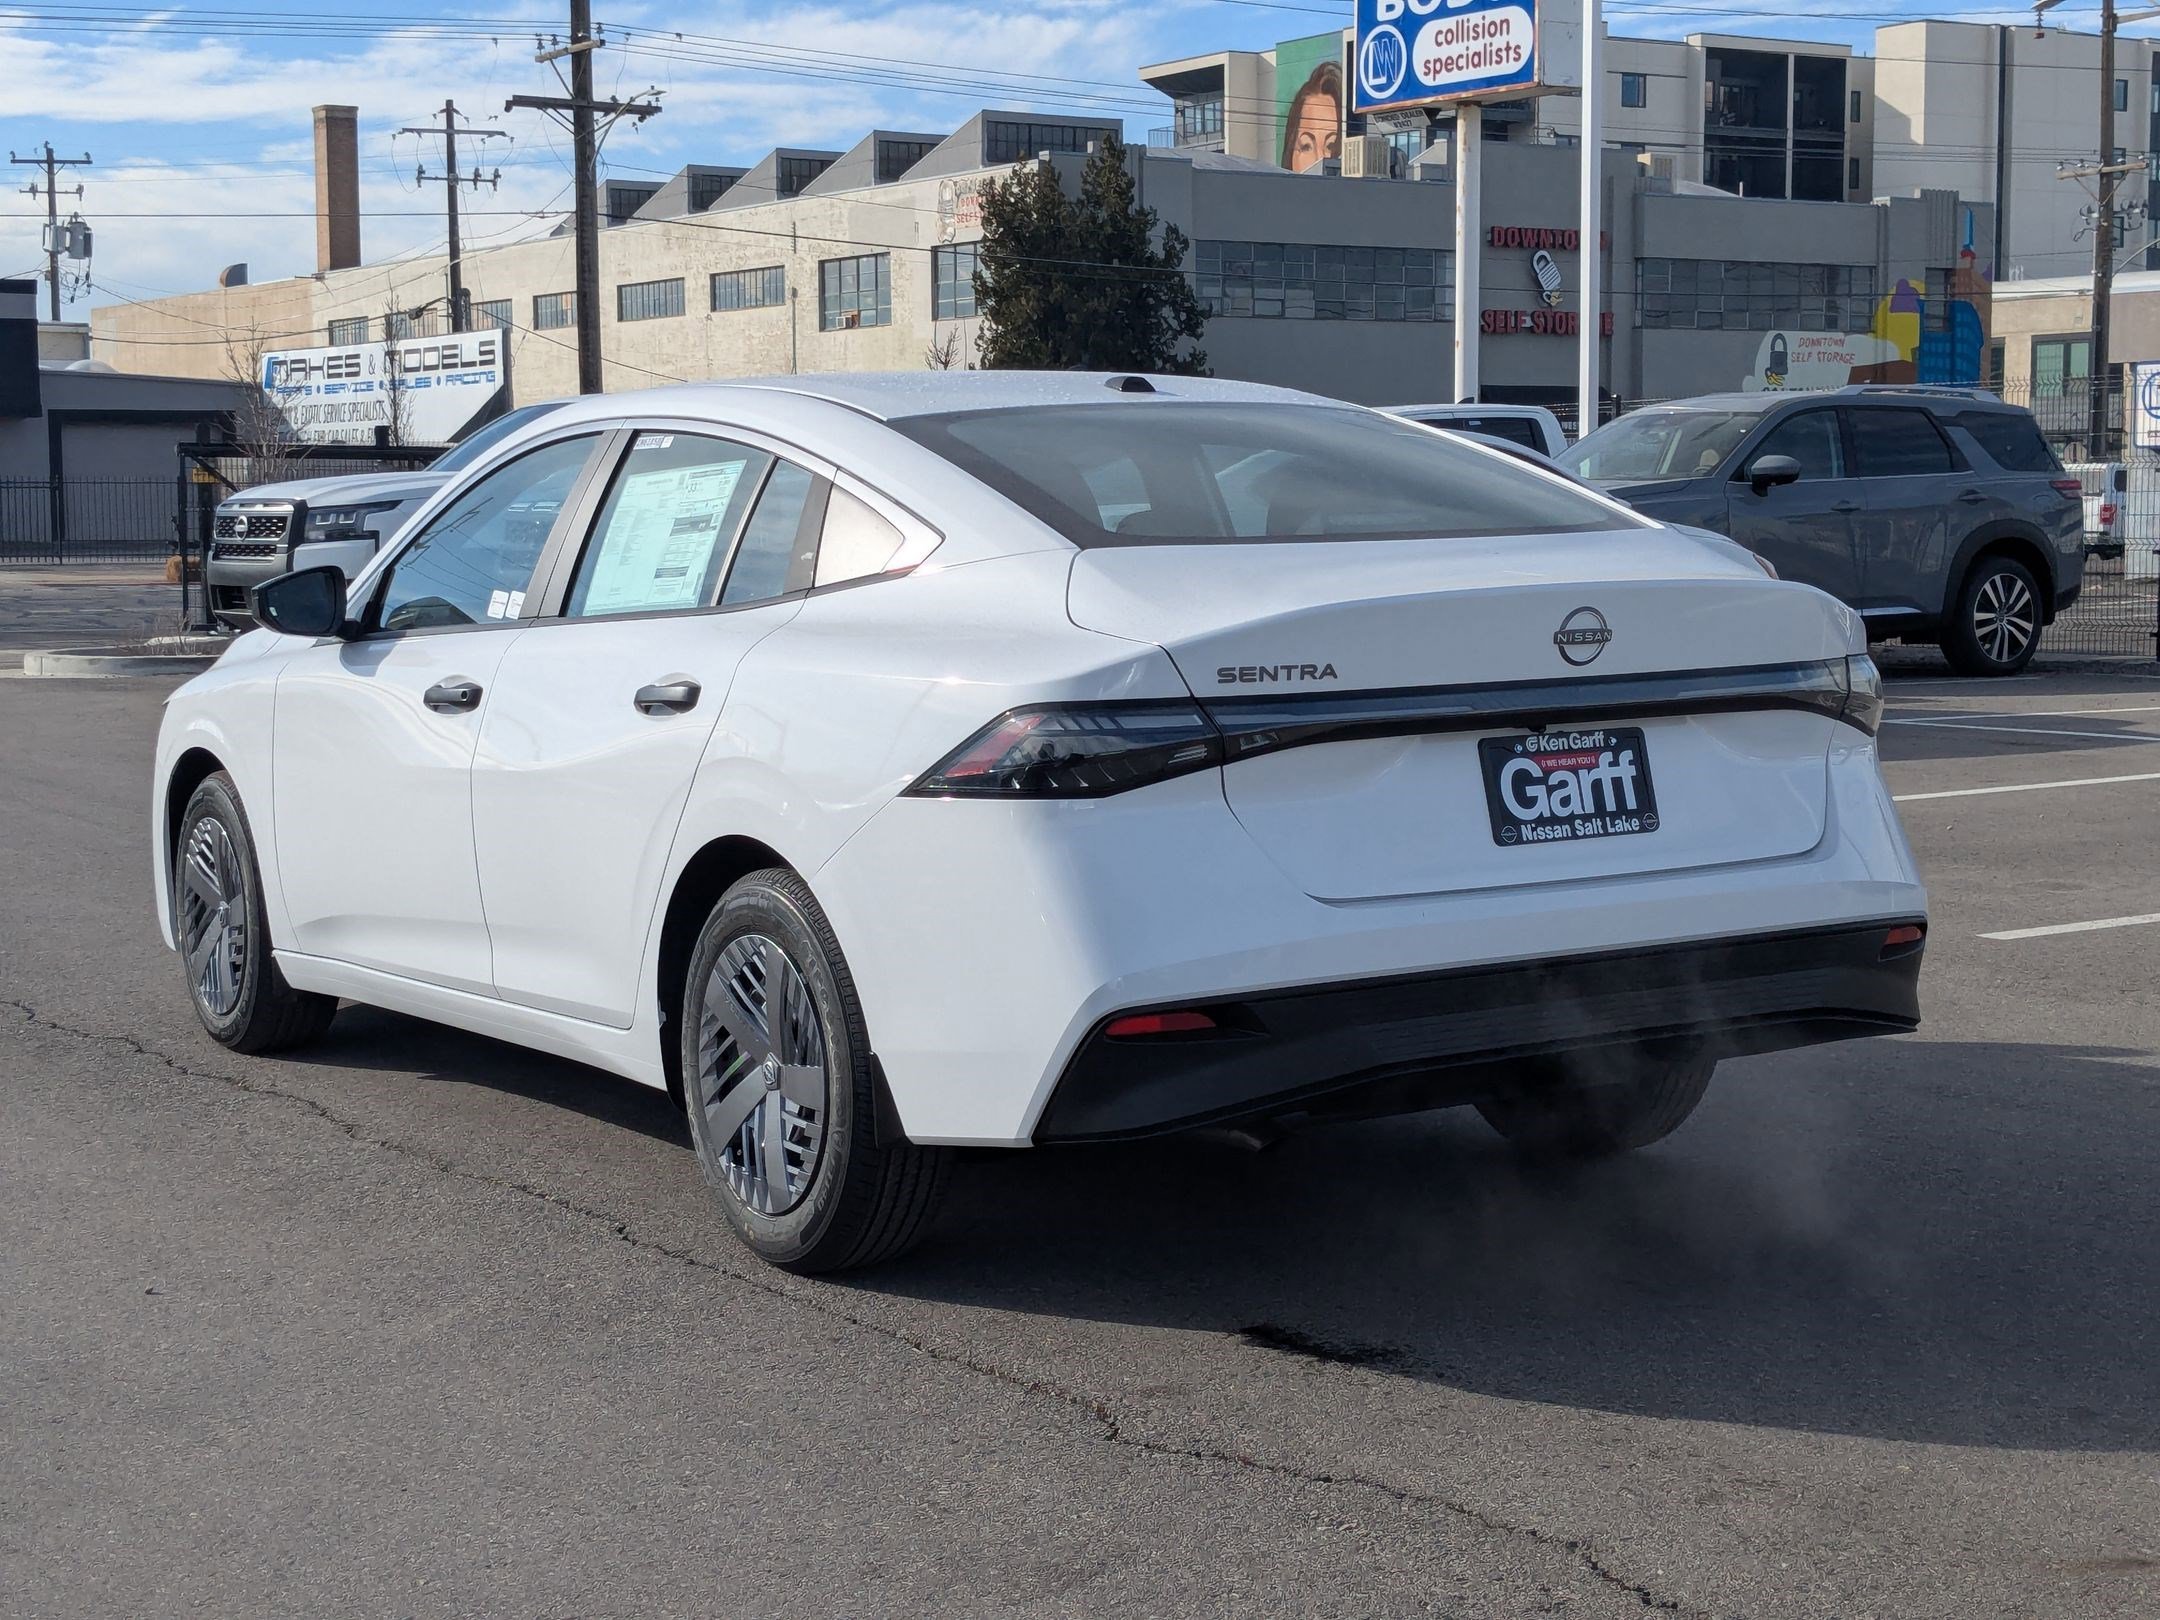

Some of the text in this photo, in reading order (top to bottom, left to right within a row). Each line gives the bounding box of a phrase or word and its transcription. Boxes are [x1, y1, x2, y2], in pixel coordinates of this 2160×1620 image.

[1434, 15, 1511, 47] collision
[1423, 42, 1522, 81] specialists
[1492, 226, 1608, 250] DOWNTO
[1482, 309, 1614, 337] SELF STORE
[266, 354, 361, 383] MAKES
[324, 381, 374, 394] SERVICE
[1557, 629, 1612, 643] NISSAN
[1216, 663, 1338, 684] SENTRA
[1540, 731, 1604, 752] Ken Garff
[1500, 750, 1637, 821] Garff
[1520, 823, 1572, 841] Nissan
[1575, 818, 1603, 836] Salt
[1605, 816, 1640, 833] Lake
